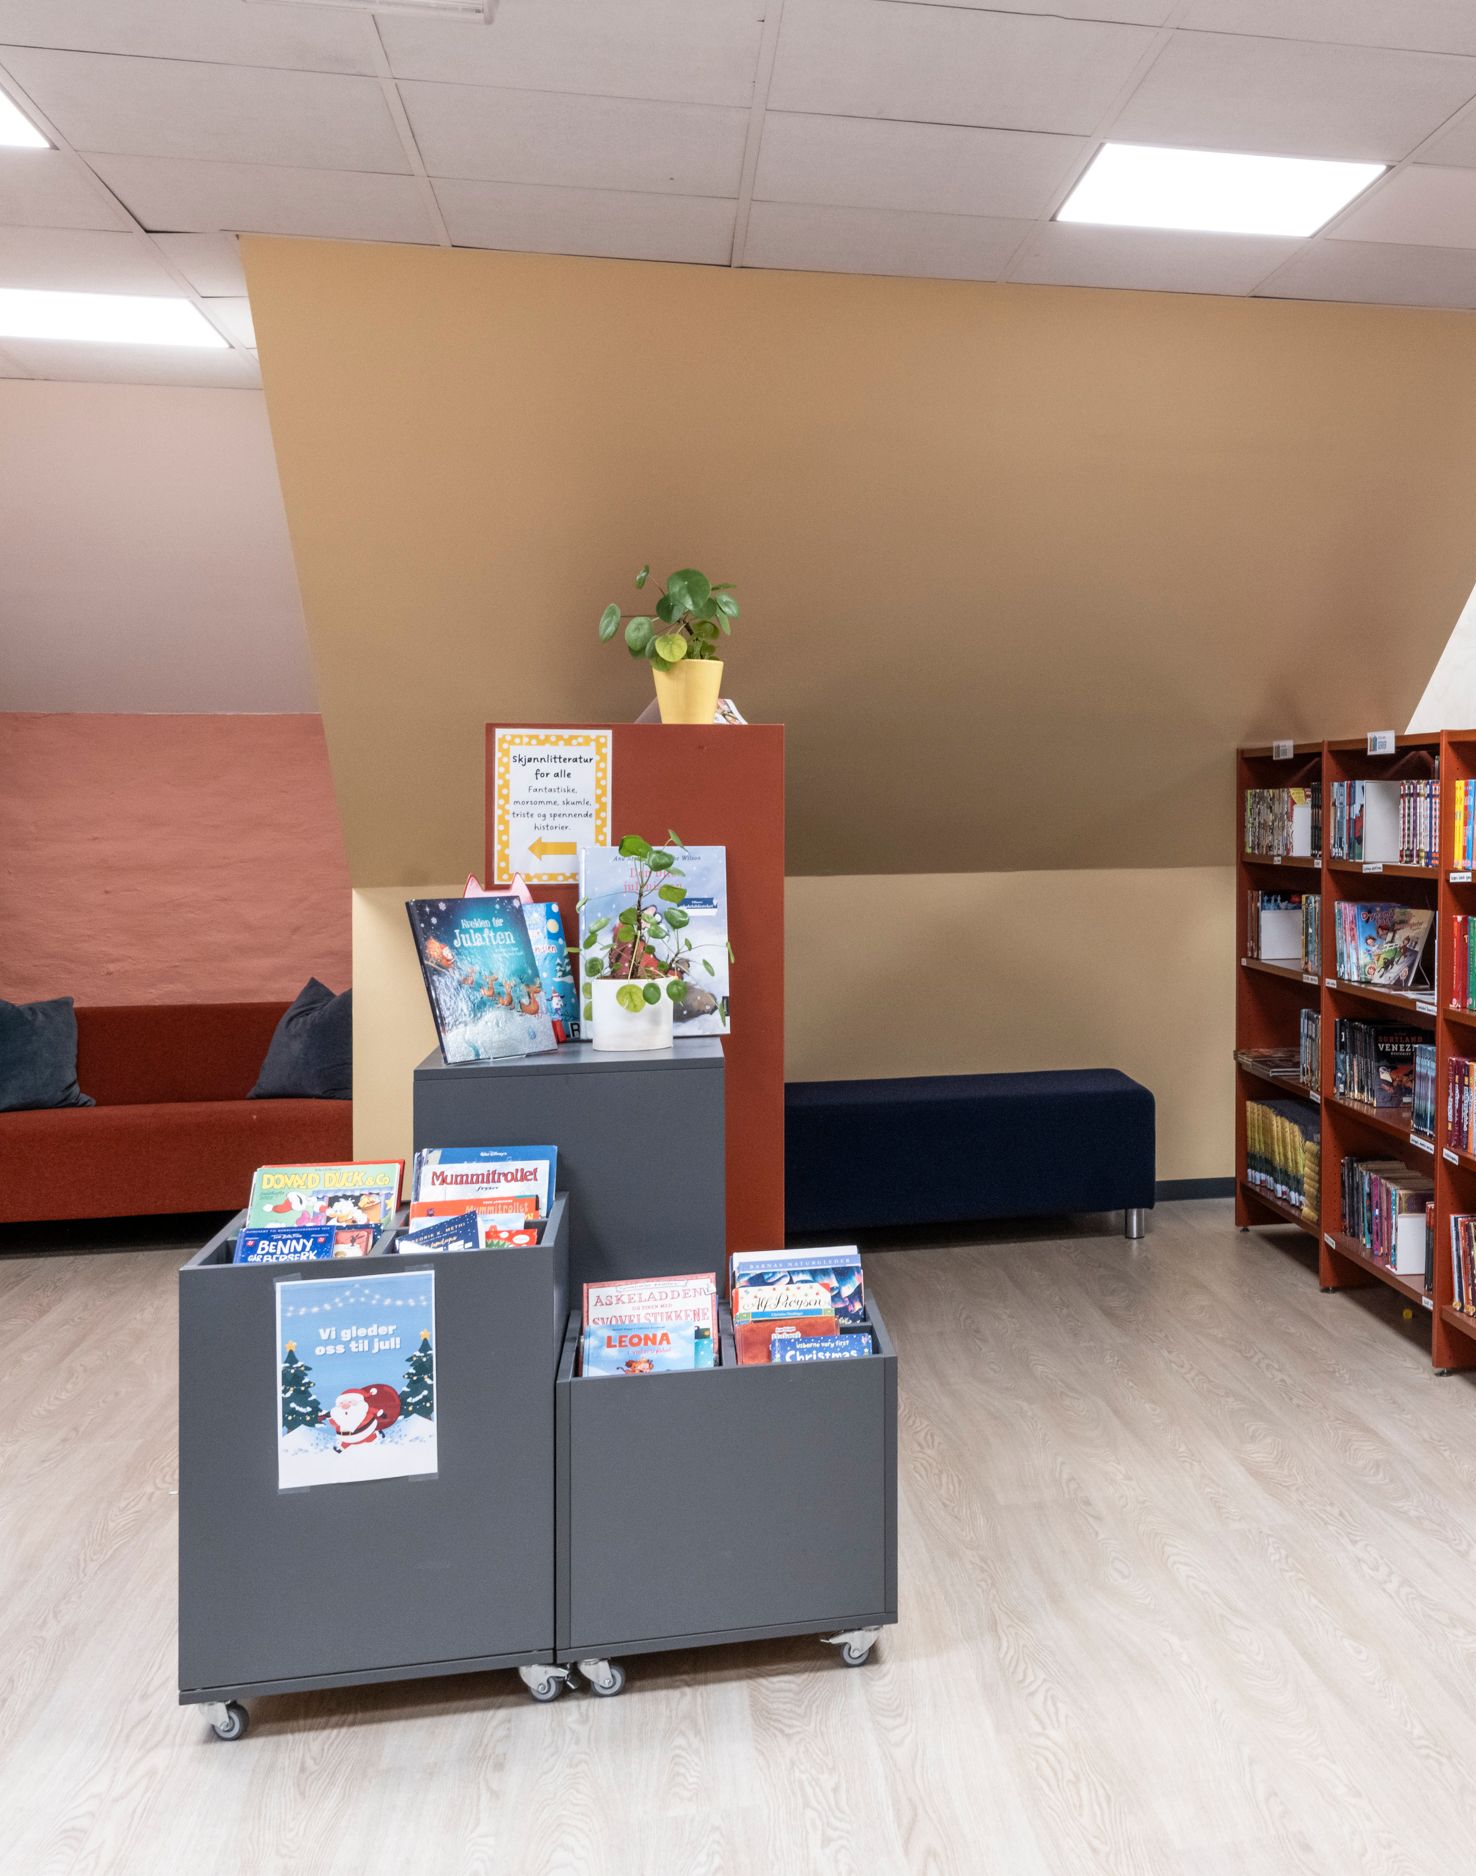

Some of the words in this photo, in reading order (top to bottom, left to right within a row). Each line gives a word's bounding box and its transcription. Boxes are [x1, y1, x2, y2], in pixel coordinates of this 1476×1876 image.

[512, 754, 594, 766] Skjønnlitteratur
[535, 769, 550, 780] for
[553, 769, 572, 778] alle
[528, 786, 578, 794] Fantastiske,
[562, 798, 592, 806] skumle,
[537, 812, 547, 821] og
[549, 811, 593, 821] spennende
[534, 823, 571, 831] historier.
[461, 918, 491, 929] Kvelden
[453, 928, 516, 948] Julaften
[262, 1173, 320, 1189] DONALD
[324, 1171, 365, 1188] DUCK
[431, 1167, 538, 1186] Mummitrollet
[257, 1238, 314, 1255] BENNY
[593, 1287, 708, 1307] ASKELADDEN
[770, 1292, 822, 1311] Prøysen
[319, 1327, 336, 1341] Vi
[341, 1323, 397, 1341] gleder
[606, 1331, 671, 1349] LEONA
[315, 1344, 346, 1356] oss
[349, 1339, 369, 1352] til
[371, 1337, 401, 1354] jul!
[785, 1350, 858, 1362] Christmas
